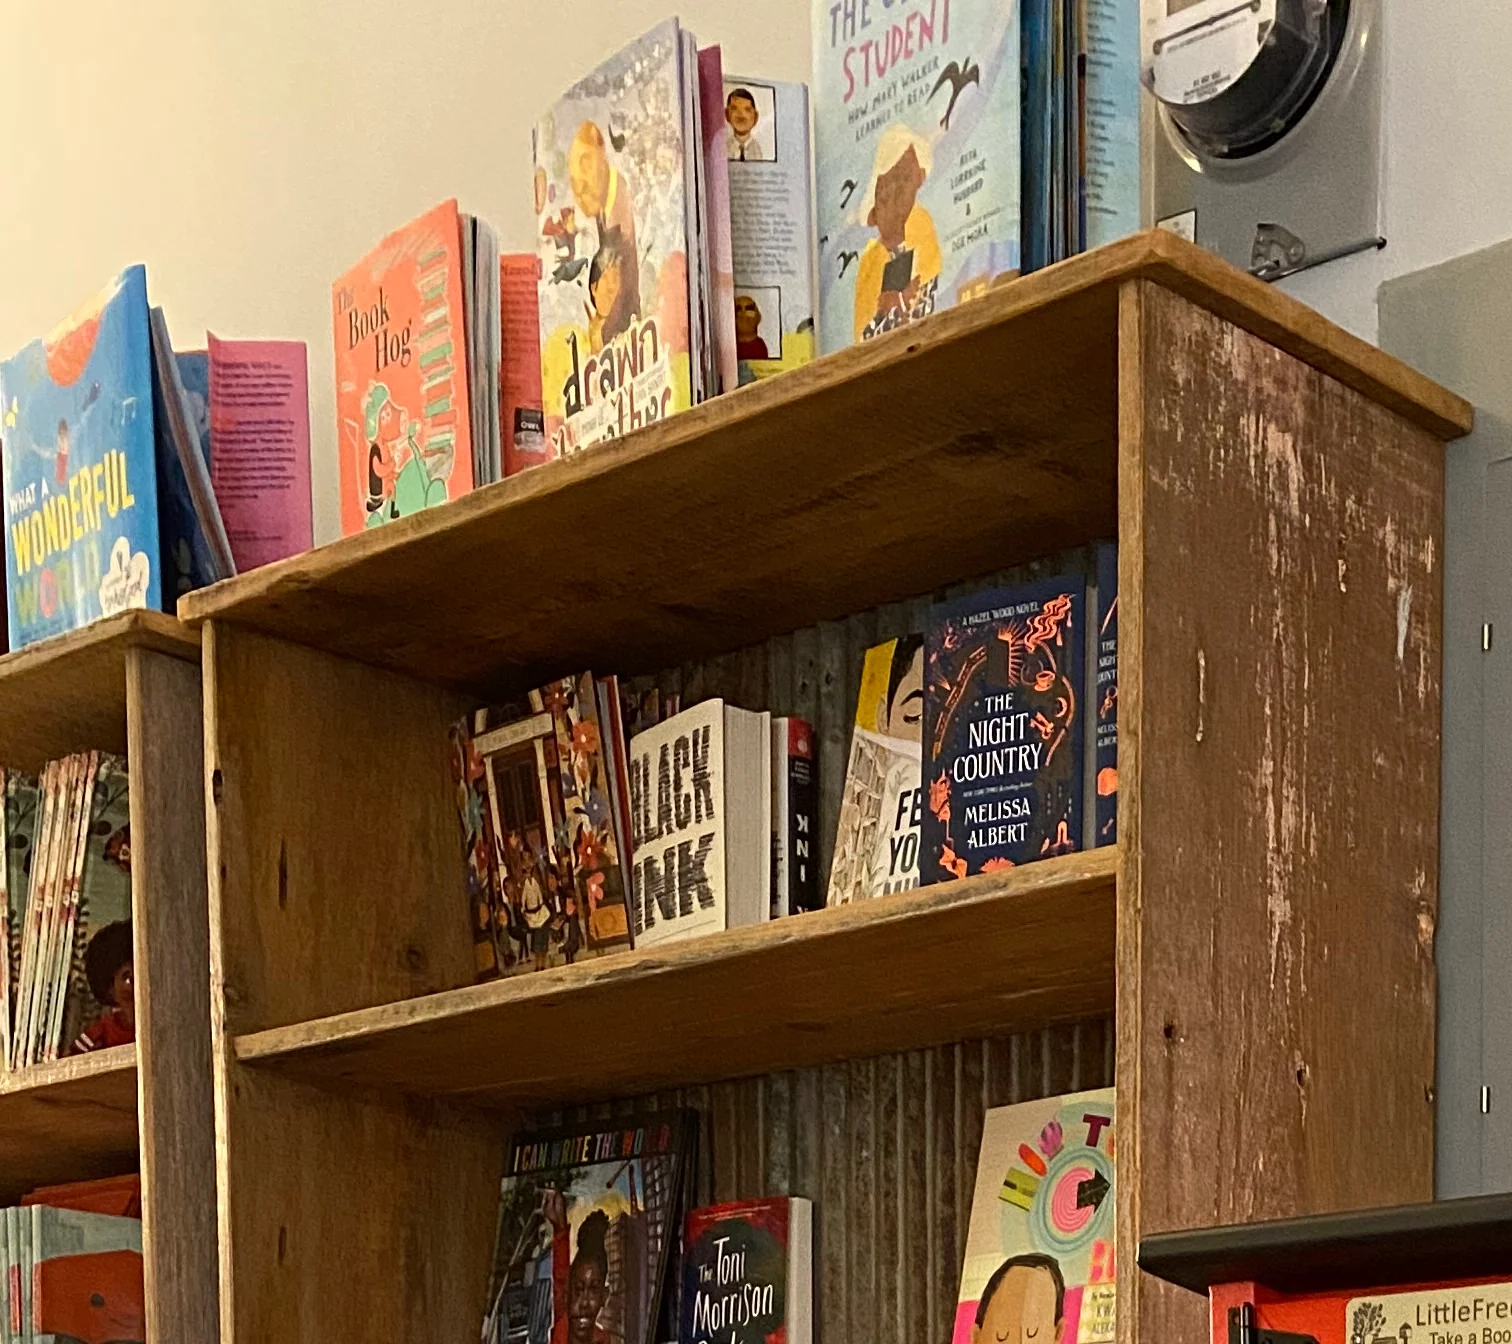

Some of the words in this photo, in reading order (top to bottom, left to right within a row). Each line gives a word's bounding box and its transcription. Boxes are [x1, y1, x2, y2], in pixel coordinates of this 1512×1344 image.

[348, 287, 391, 350] Book
[375, 322, 412, 373] Hog
[562, 319, 659, 419] drawn
[8, 483, 36, 515] WHAT
[41, 476, 49, 496] A
[11, 448, 135, 577] WONDERFUL
[984, 692, 1014, 713] THE
[968, 712, 1030, 749] NIGHT
[953, 742, 1043, 782] COUNTRY
[964, 798, 1031, 826] MELISSA
[967, 822, 1028, 849] ALBERT
[713, 1236, 746, 1287] Toni
[692, 1282, 773, 1338] Morrison
